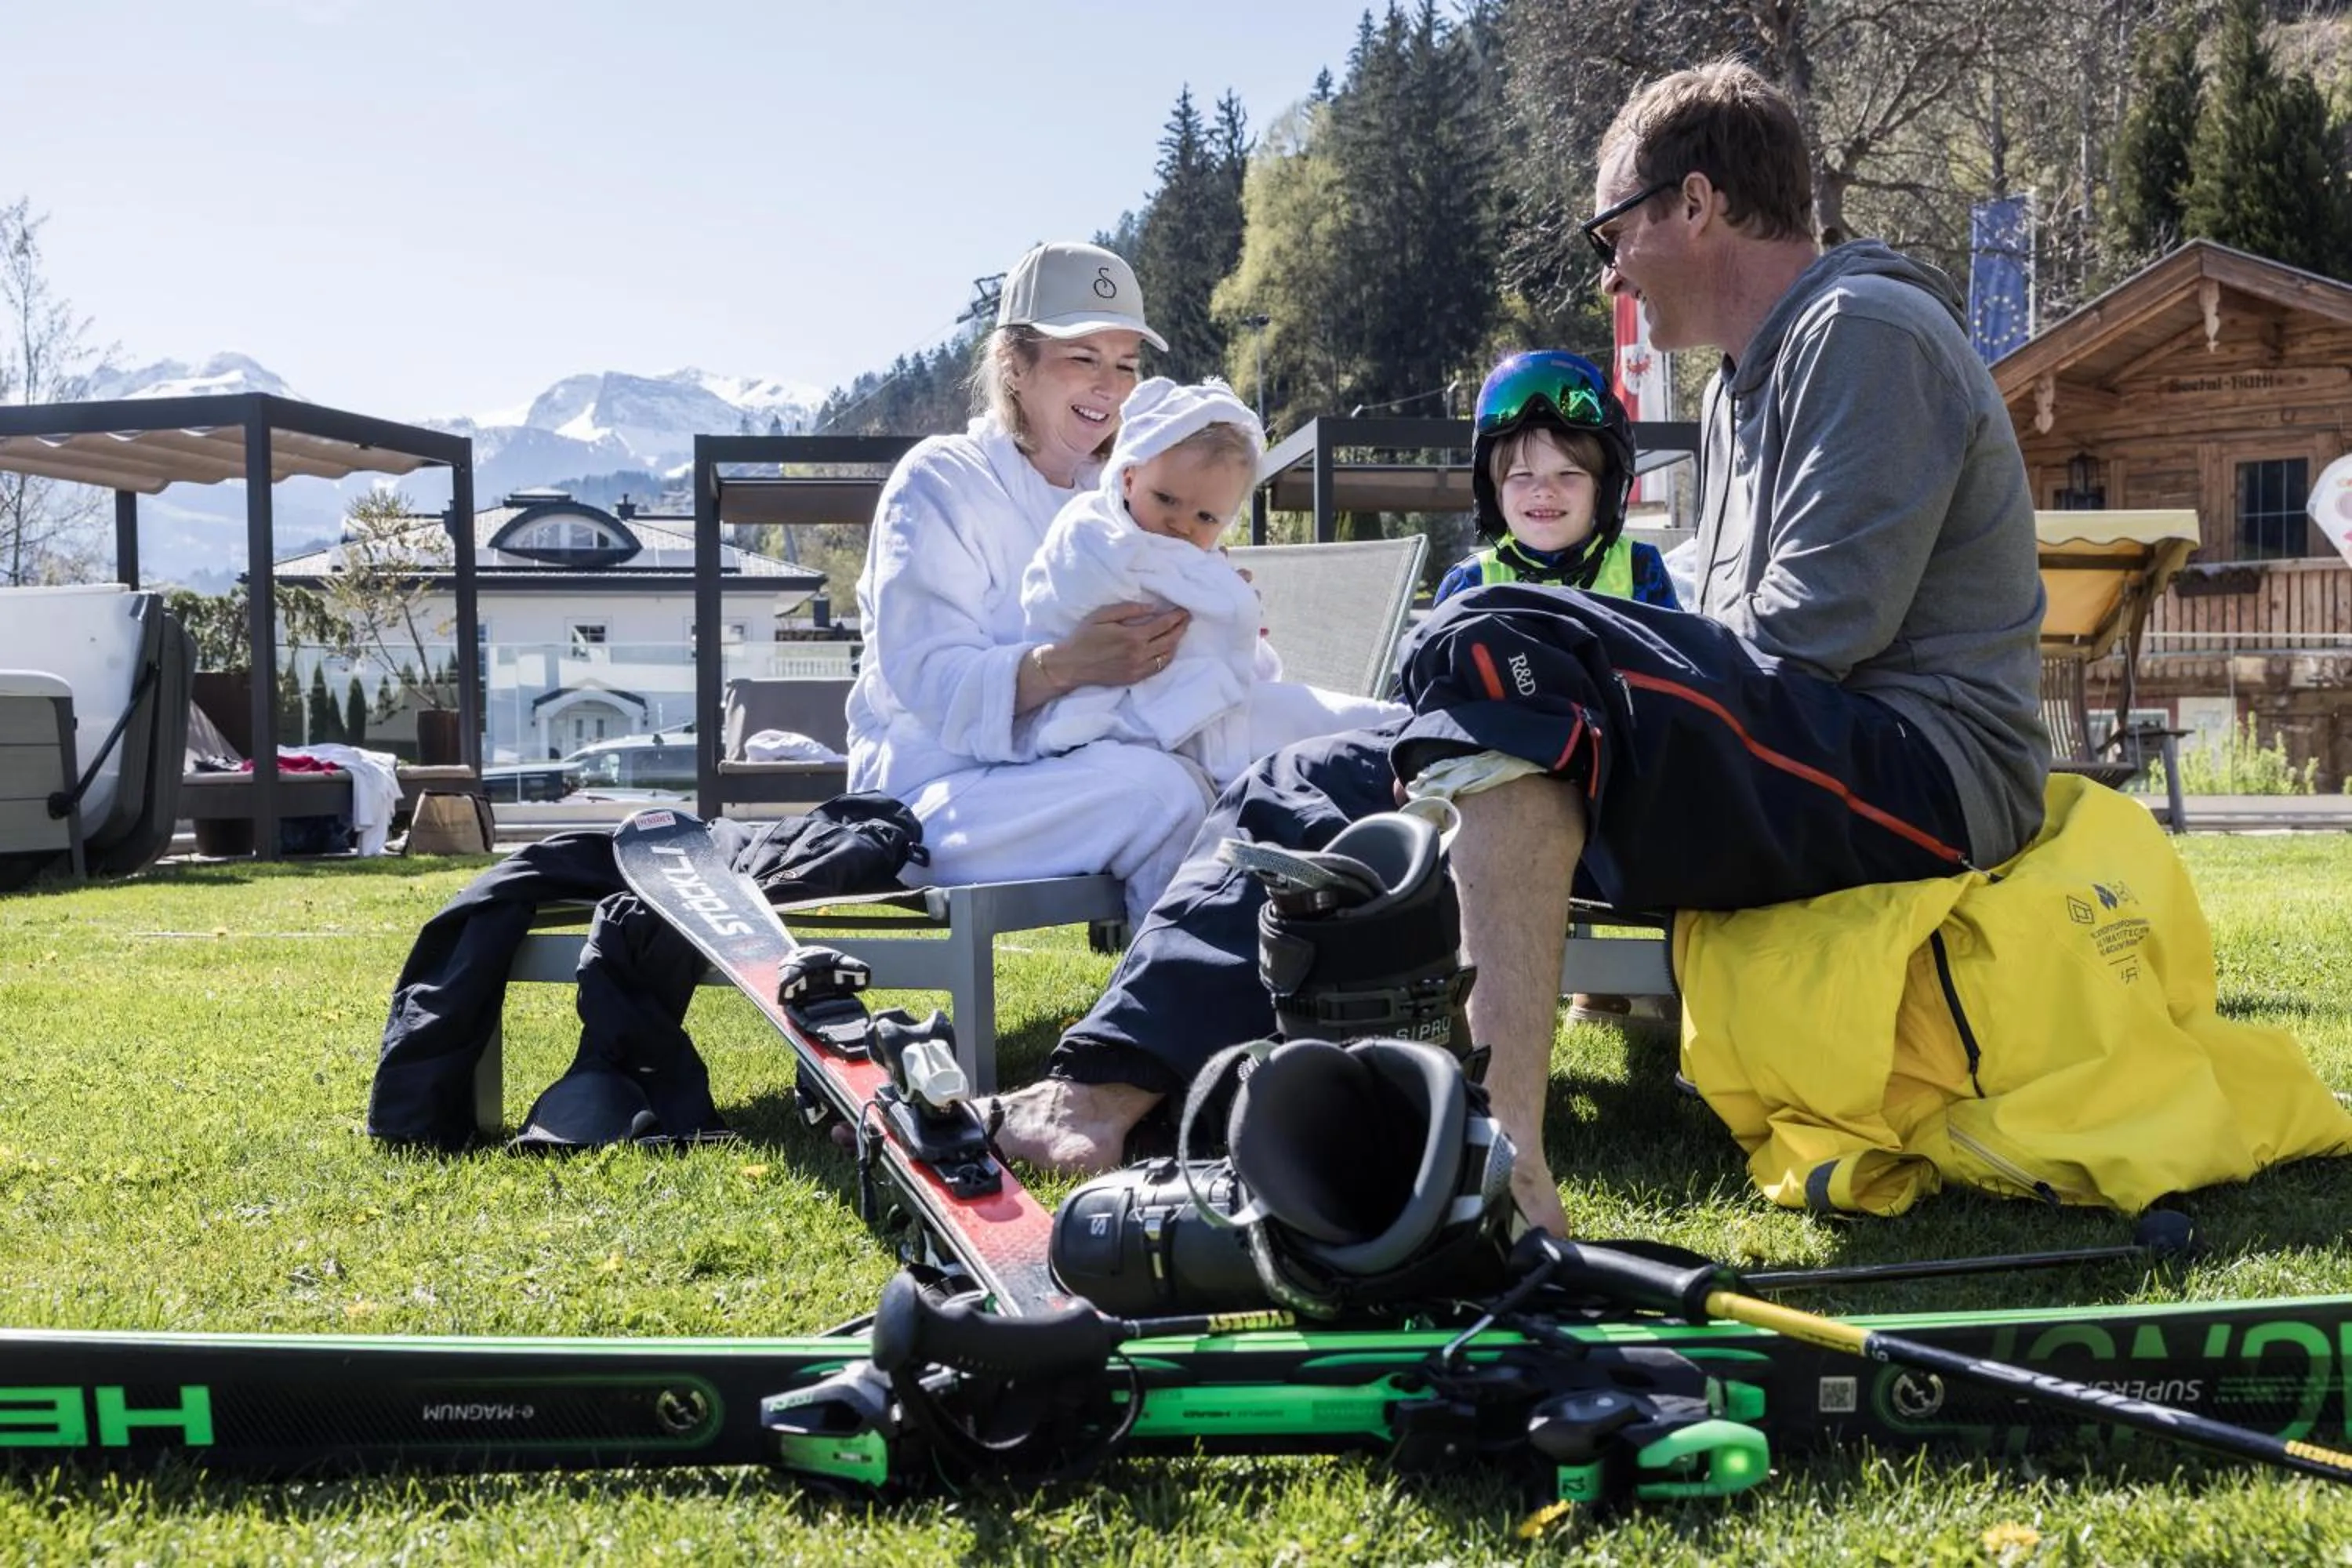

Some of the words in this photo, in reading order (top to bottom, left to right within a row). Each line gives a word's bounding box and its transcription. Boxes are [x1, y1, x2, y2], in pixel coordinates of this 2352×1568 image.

[1093, 267, 1117, 299] S
[1508, 652, 1537, 697] R&D
[651, 846, 754, 936] STÖCKLI
[423, 1403, 535, 1421] e-MAGNUM
